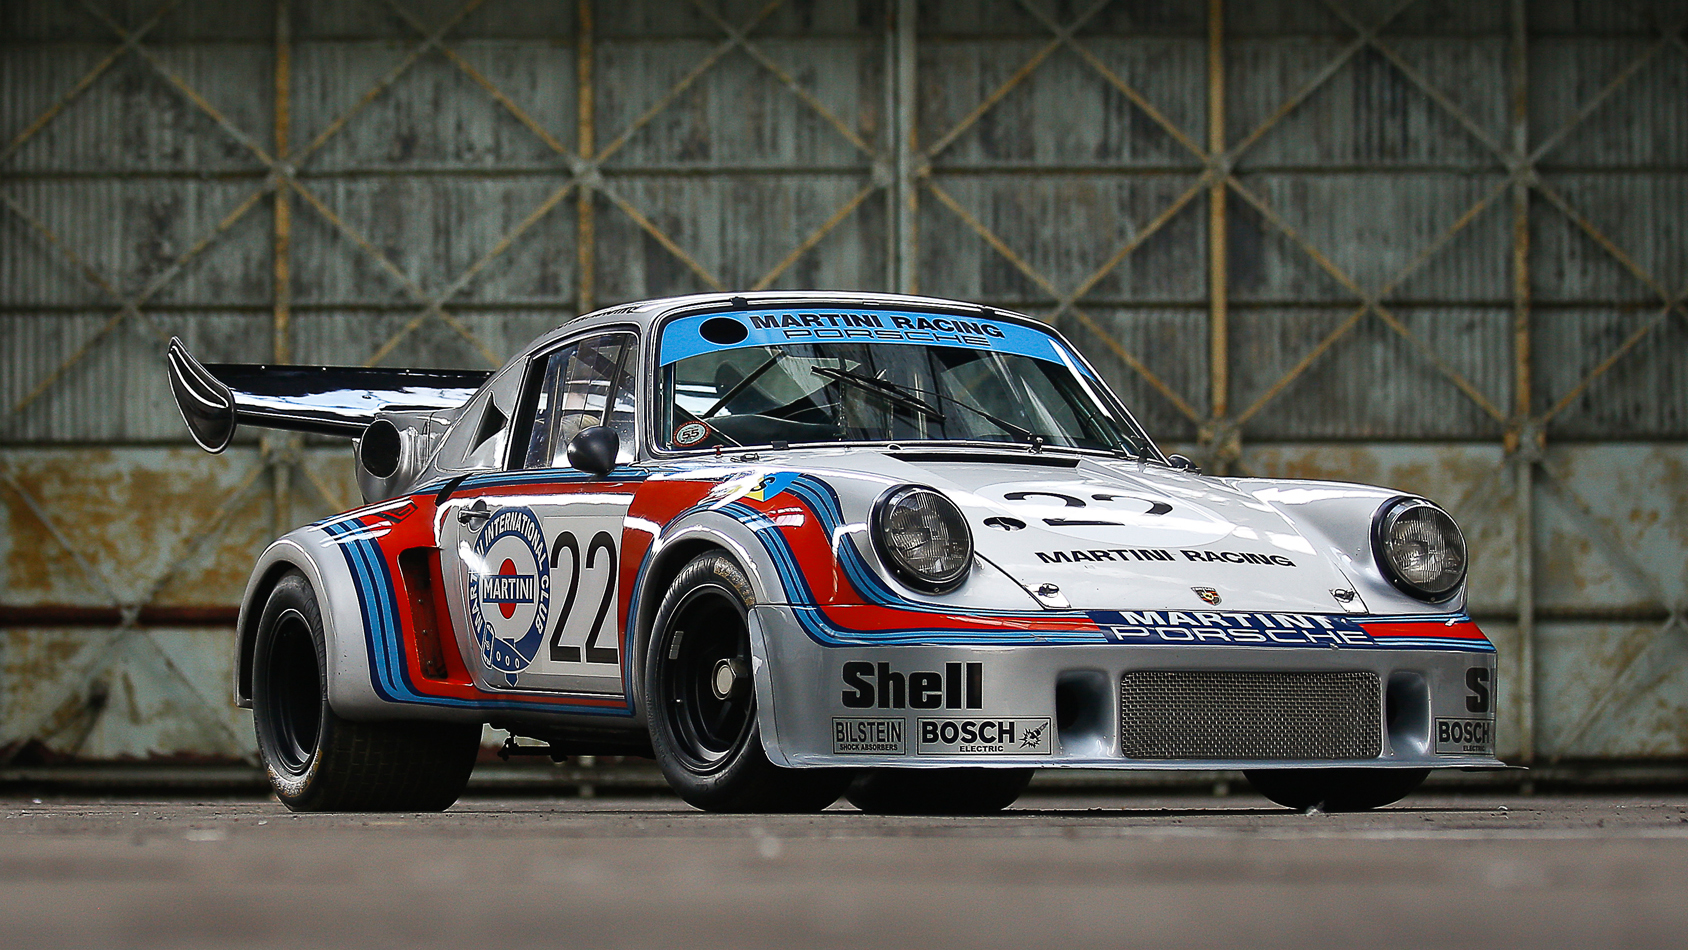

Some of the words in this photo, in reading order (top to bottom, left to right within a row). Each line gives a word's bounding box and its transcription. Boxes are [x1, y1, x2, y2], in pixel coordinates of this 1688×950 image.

[749, 313, 884, 329] MARTINI
[890, 315, 1006, 339] RACING
[783, 328, 991, 347] PORSCHE
[682, 428, 700, 441] 55
[1035, 549, 1176, 563] MARTINI
[1180, 550, 1297, 568] RACING
[484, 511, 548, 571] INTERNATIONAL
[535, 574, 550, 635] CLUB
[483, 577, 534, 601] MARTINI
[549, 530, 619, 664] 22
[1118, 611, 1335, 629] MARTINI
[1109, 626, 1375, 645] PORSCHE
[841, 661, 983, 709] Shell
[835, 721, 902, 743] BILSTEIN
[921, 720, 1016, 744] BOSCH
[1438, 721, 1490, 744] BOSCH
[839, 743, 860, 751] SHOCK
[860, 743, 898, 751] ABSORBERS
